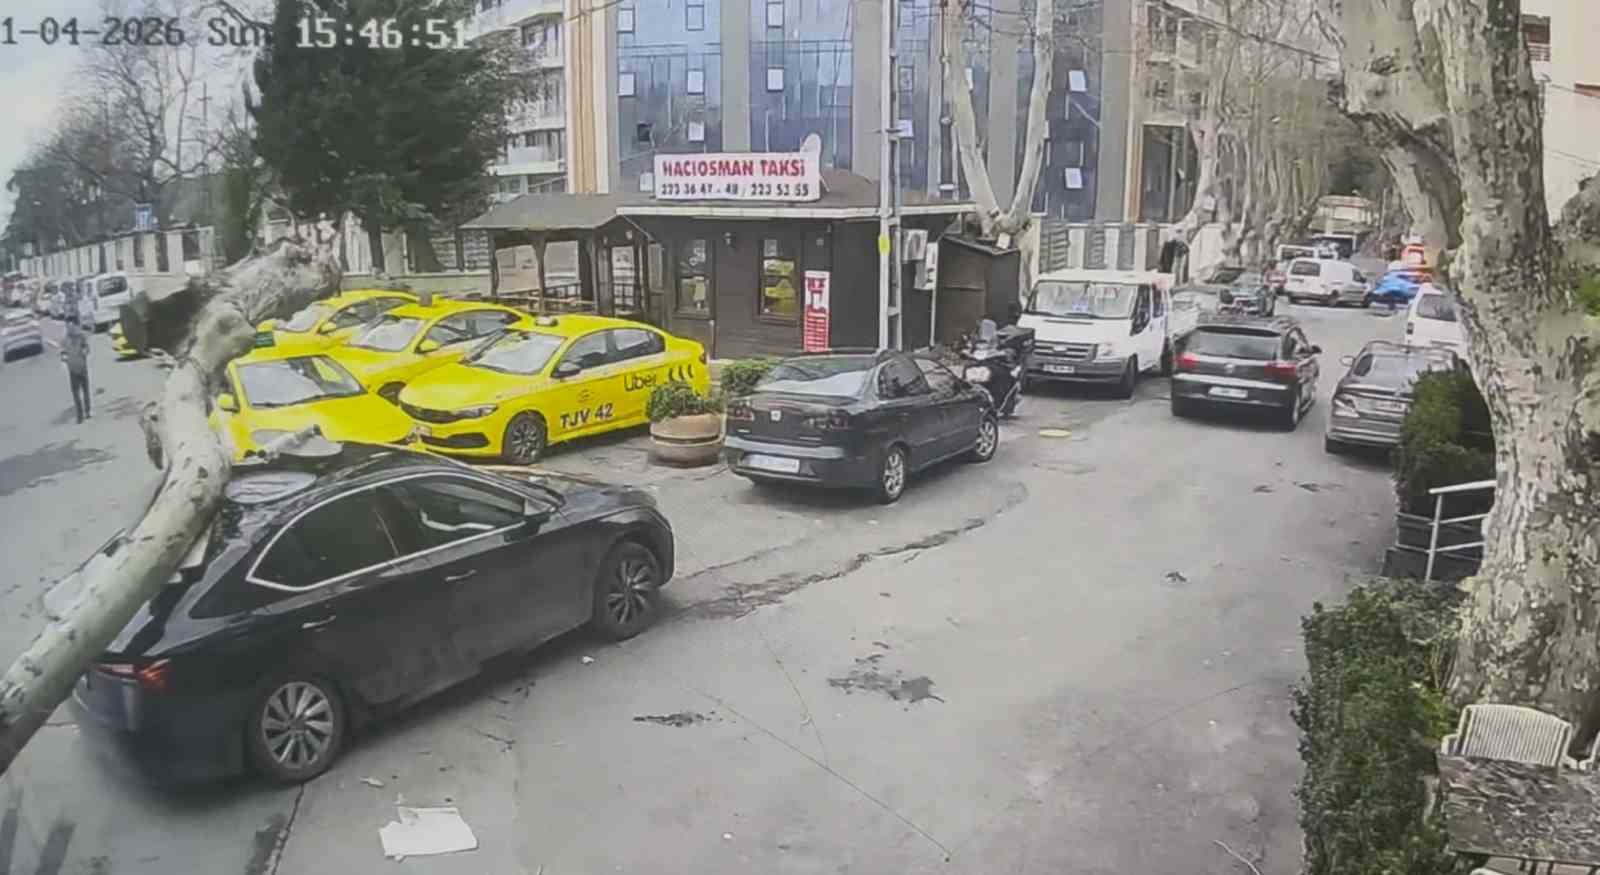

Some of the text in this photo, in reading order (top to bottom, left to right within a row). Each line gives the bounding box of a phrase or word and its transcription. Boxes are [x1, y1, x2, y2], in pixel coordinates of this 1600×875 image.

[662, 160, 754, 177] HACIOSMAN
[624, 374, 657, 392] Uber
[560, 403, 614, 429] TJV 42
